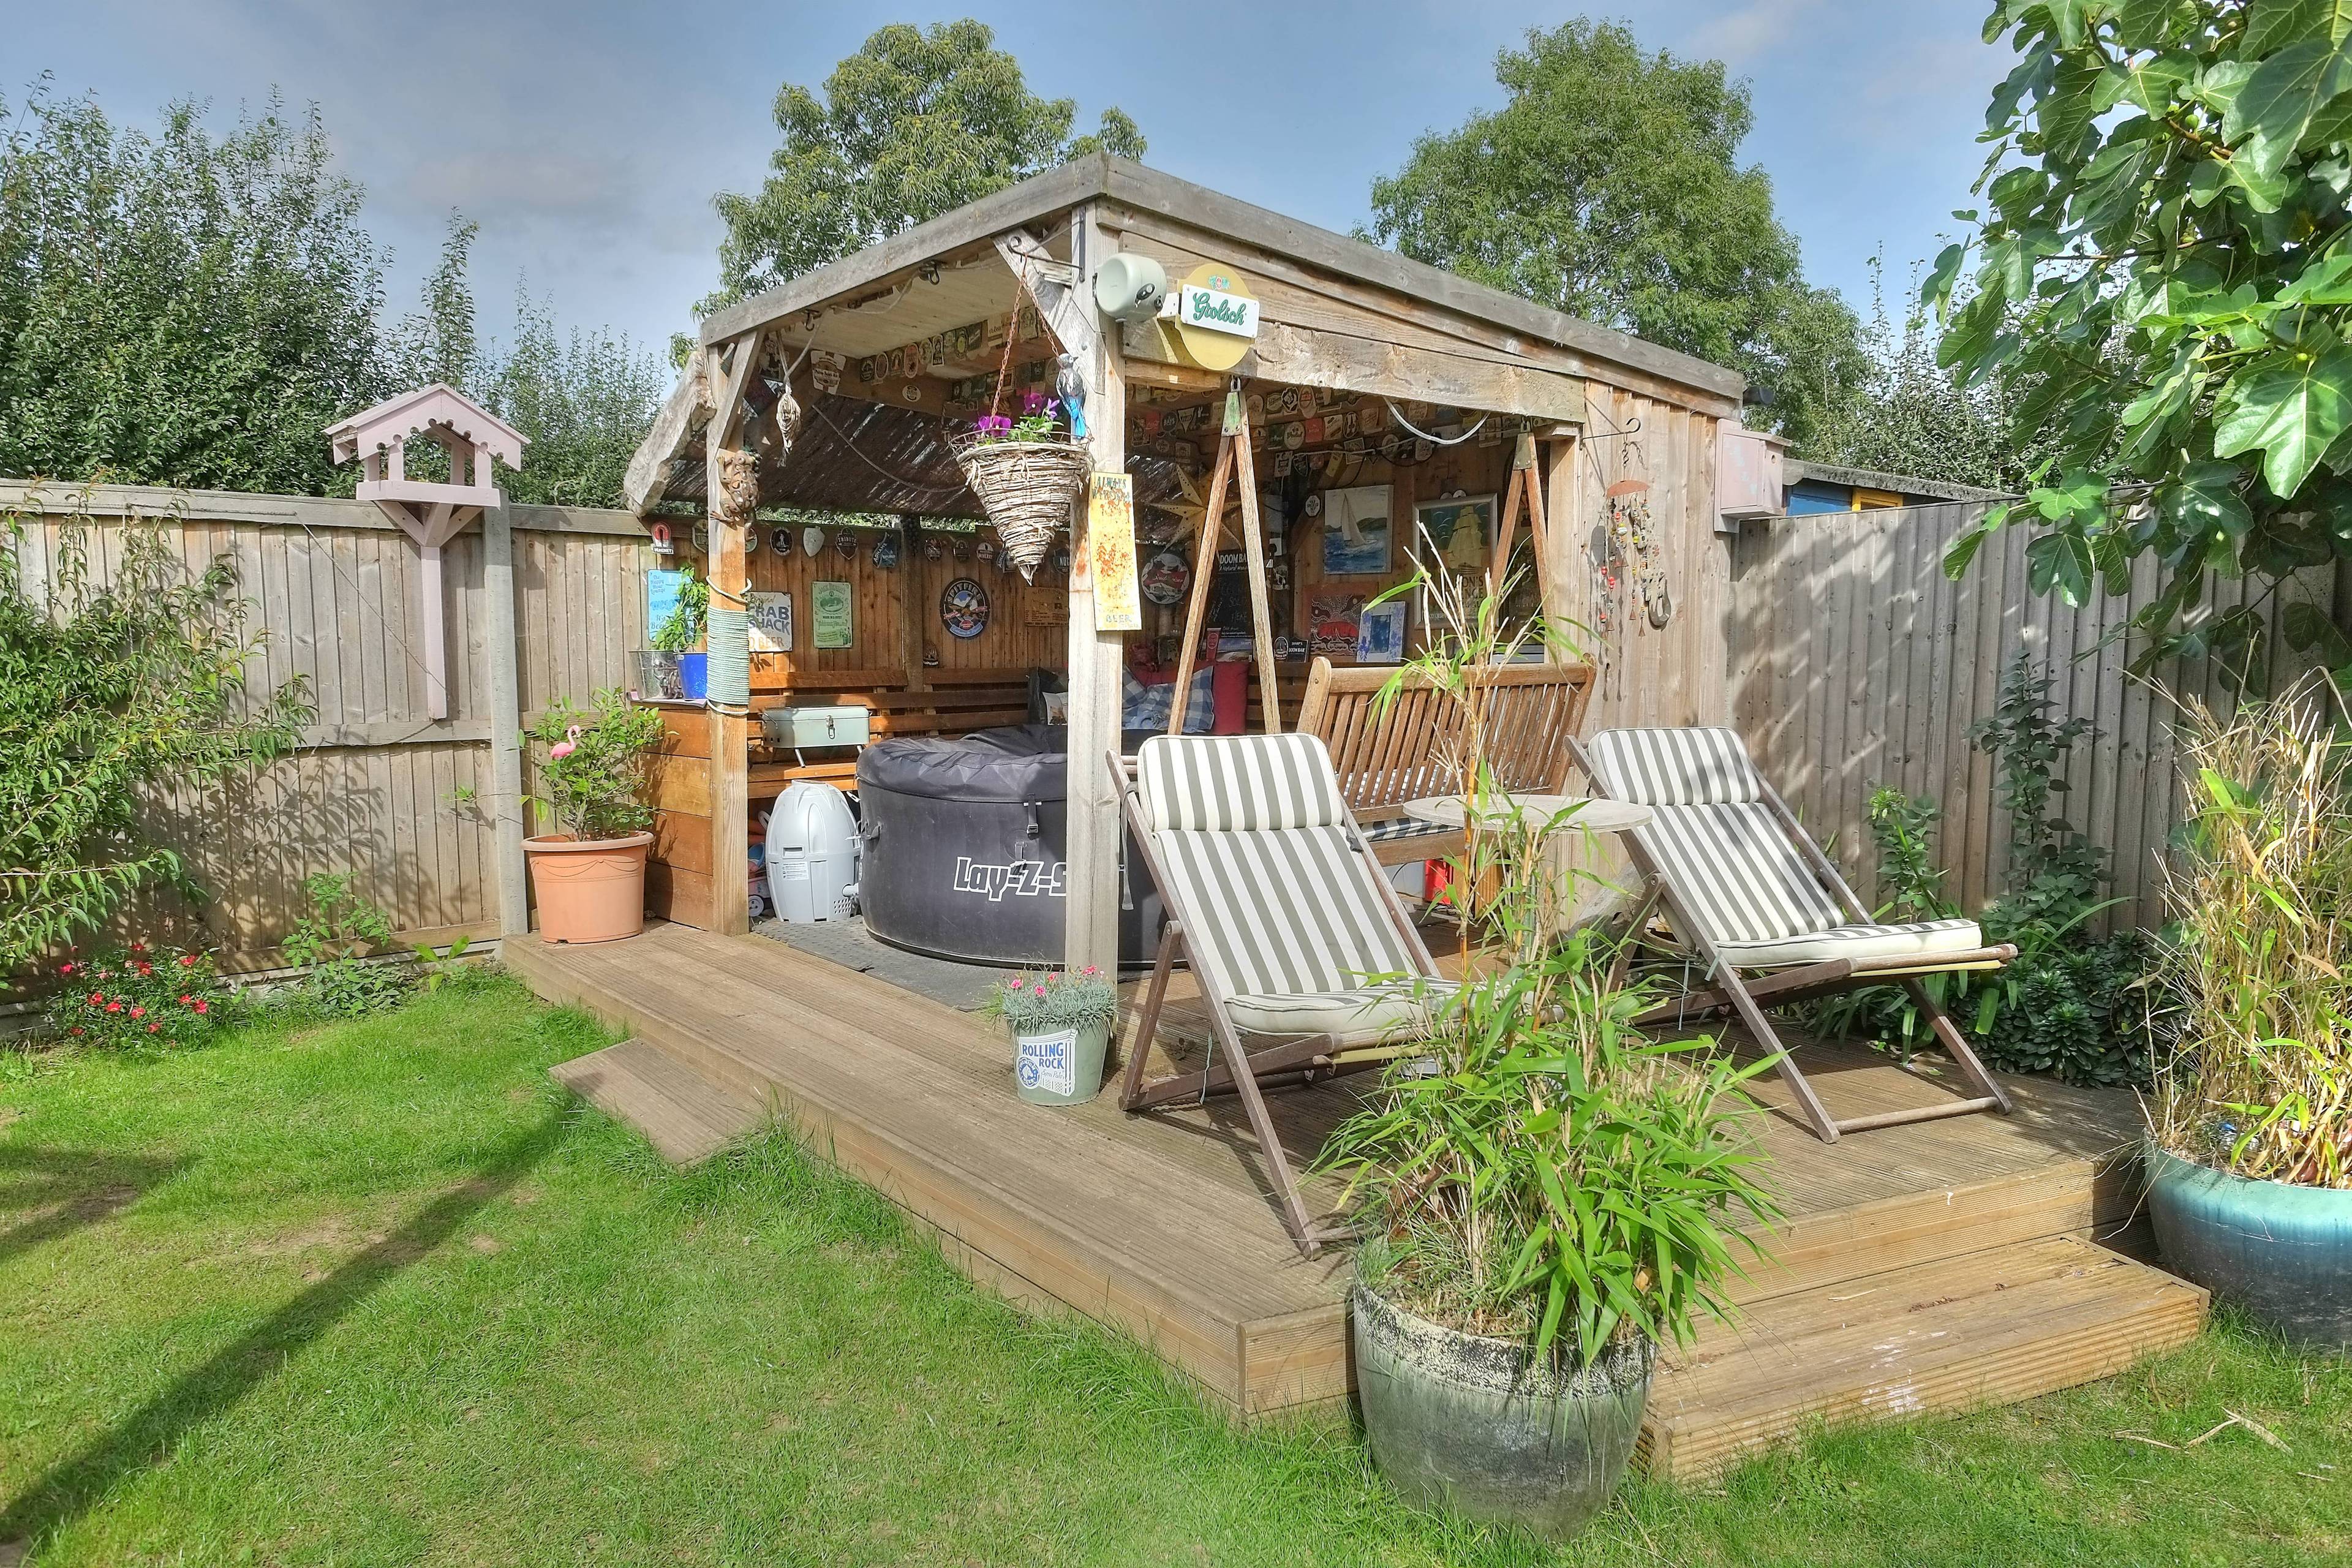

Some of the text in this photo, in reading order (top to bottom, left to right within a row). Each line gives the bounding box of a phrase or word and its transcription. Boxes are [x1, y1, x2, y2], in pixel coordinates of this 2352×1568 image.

[1193, 292, 1245, 325] Grolsch
[1220, 552, 1247, 564] DOOM BA
[1106, 614, 1132, 623] BEER
[748, 616, 791, 636] SHACK
[758, 637, 785, 649] BEER
[954, 856, 1066, 902] Lay-Z-S
[1022, 1042, 1064, 1057] ROLLING
[1039, 1058, 1065, 1069] ROCK
